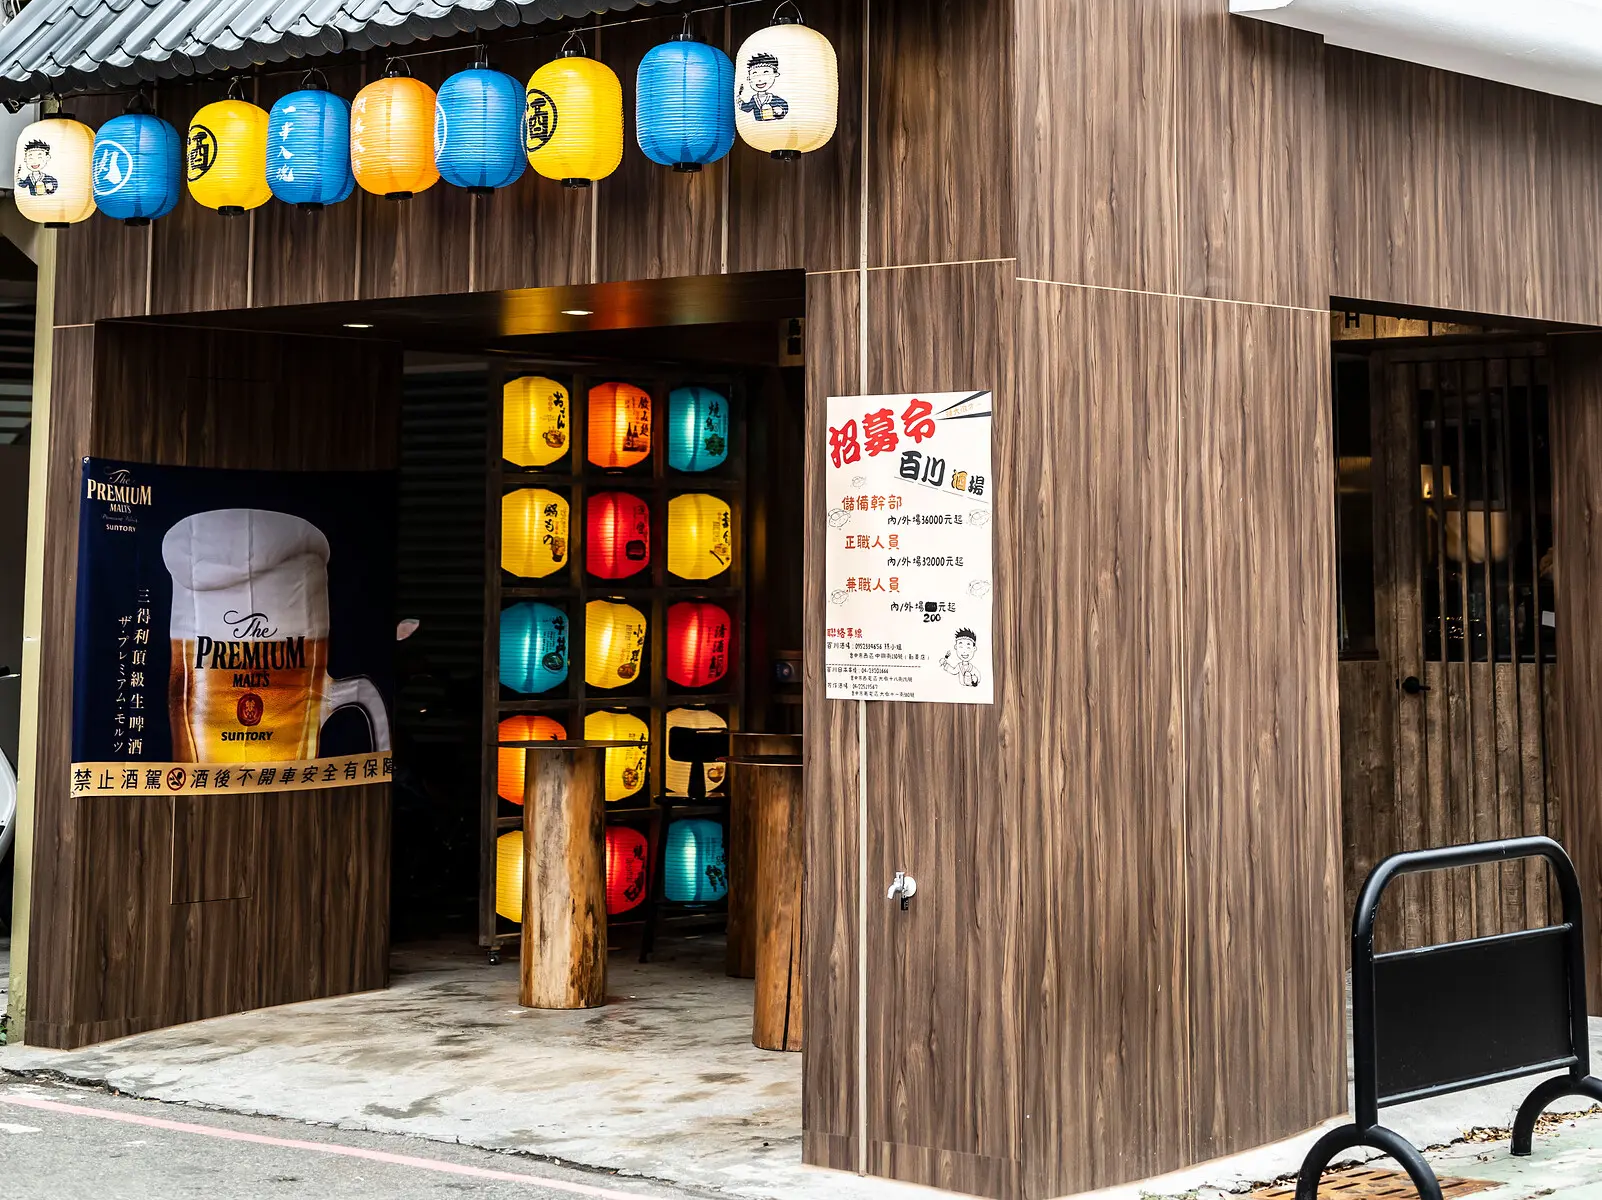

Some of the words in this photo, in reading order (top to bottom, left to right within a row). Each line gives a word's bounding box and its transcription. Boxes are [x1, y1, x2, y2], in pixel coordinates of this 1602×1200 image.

[829, 398, 936, 469] 招募令
[87, 478, 152, 506] PREMIUM
[841, 494, 903, 512] 儲備幹部
[844, 534, 899, 550] 正職人員
[845, 576, 901, 593] 兼職人員
[223, 610, 278, 639] The
[923, 613, 941, 623] 200
[194, 635, 306, 670] PREMIUM
[128, 588, 151, 755] 三得利頂級生啤酒
[221, 731, 274, 742] SUNTORY
[73, 767, 163, 792] 禁止酒駕
